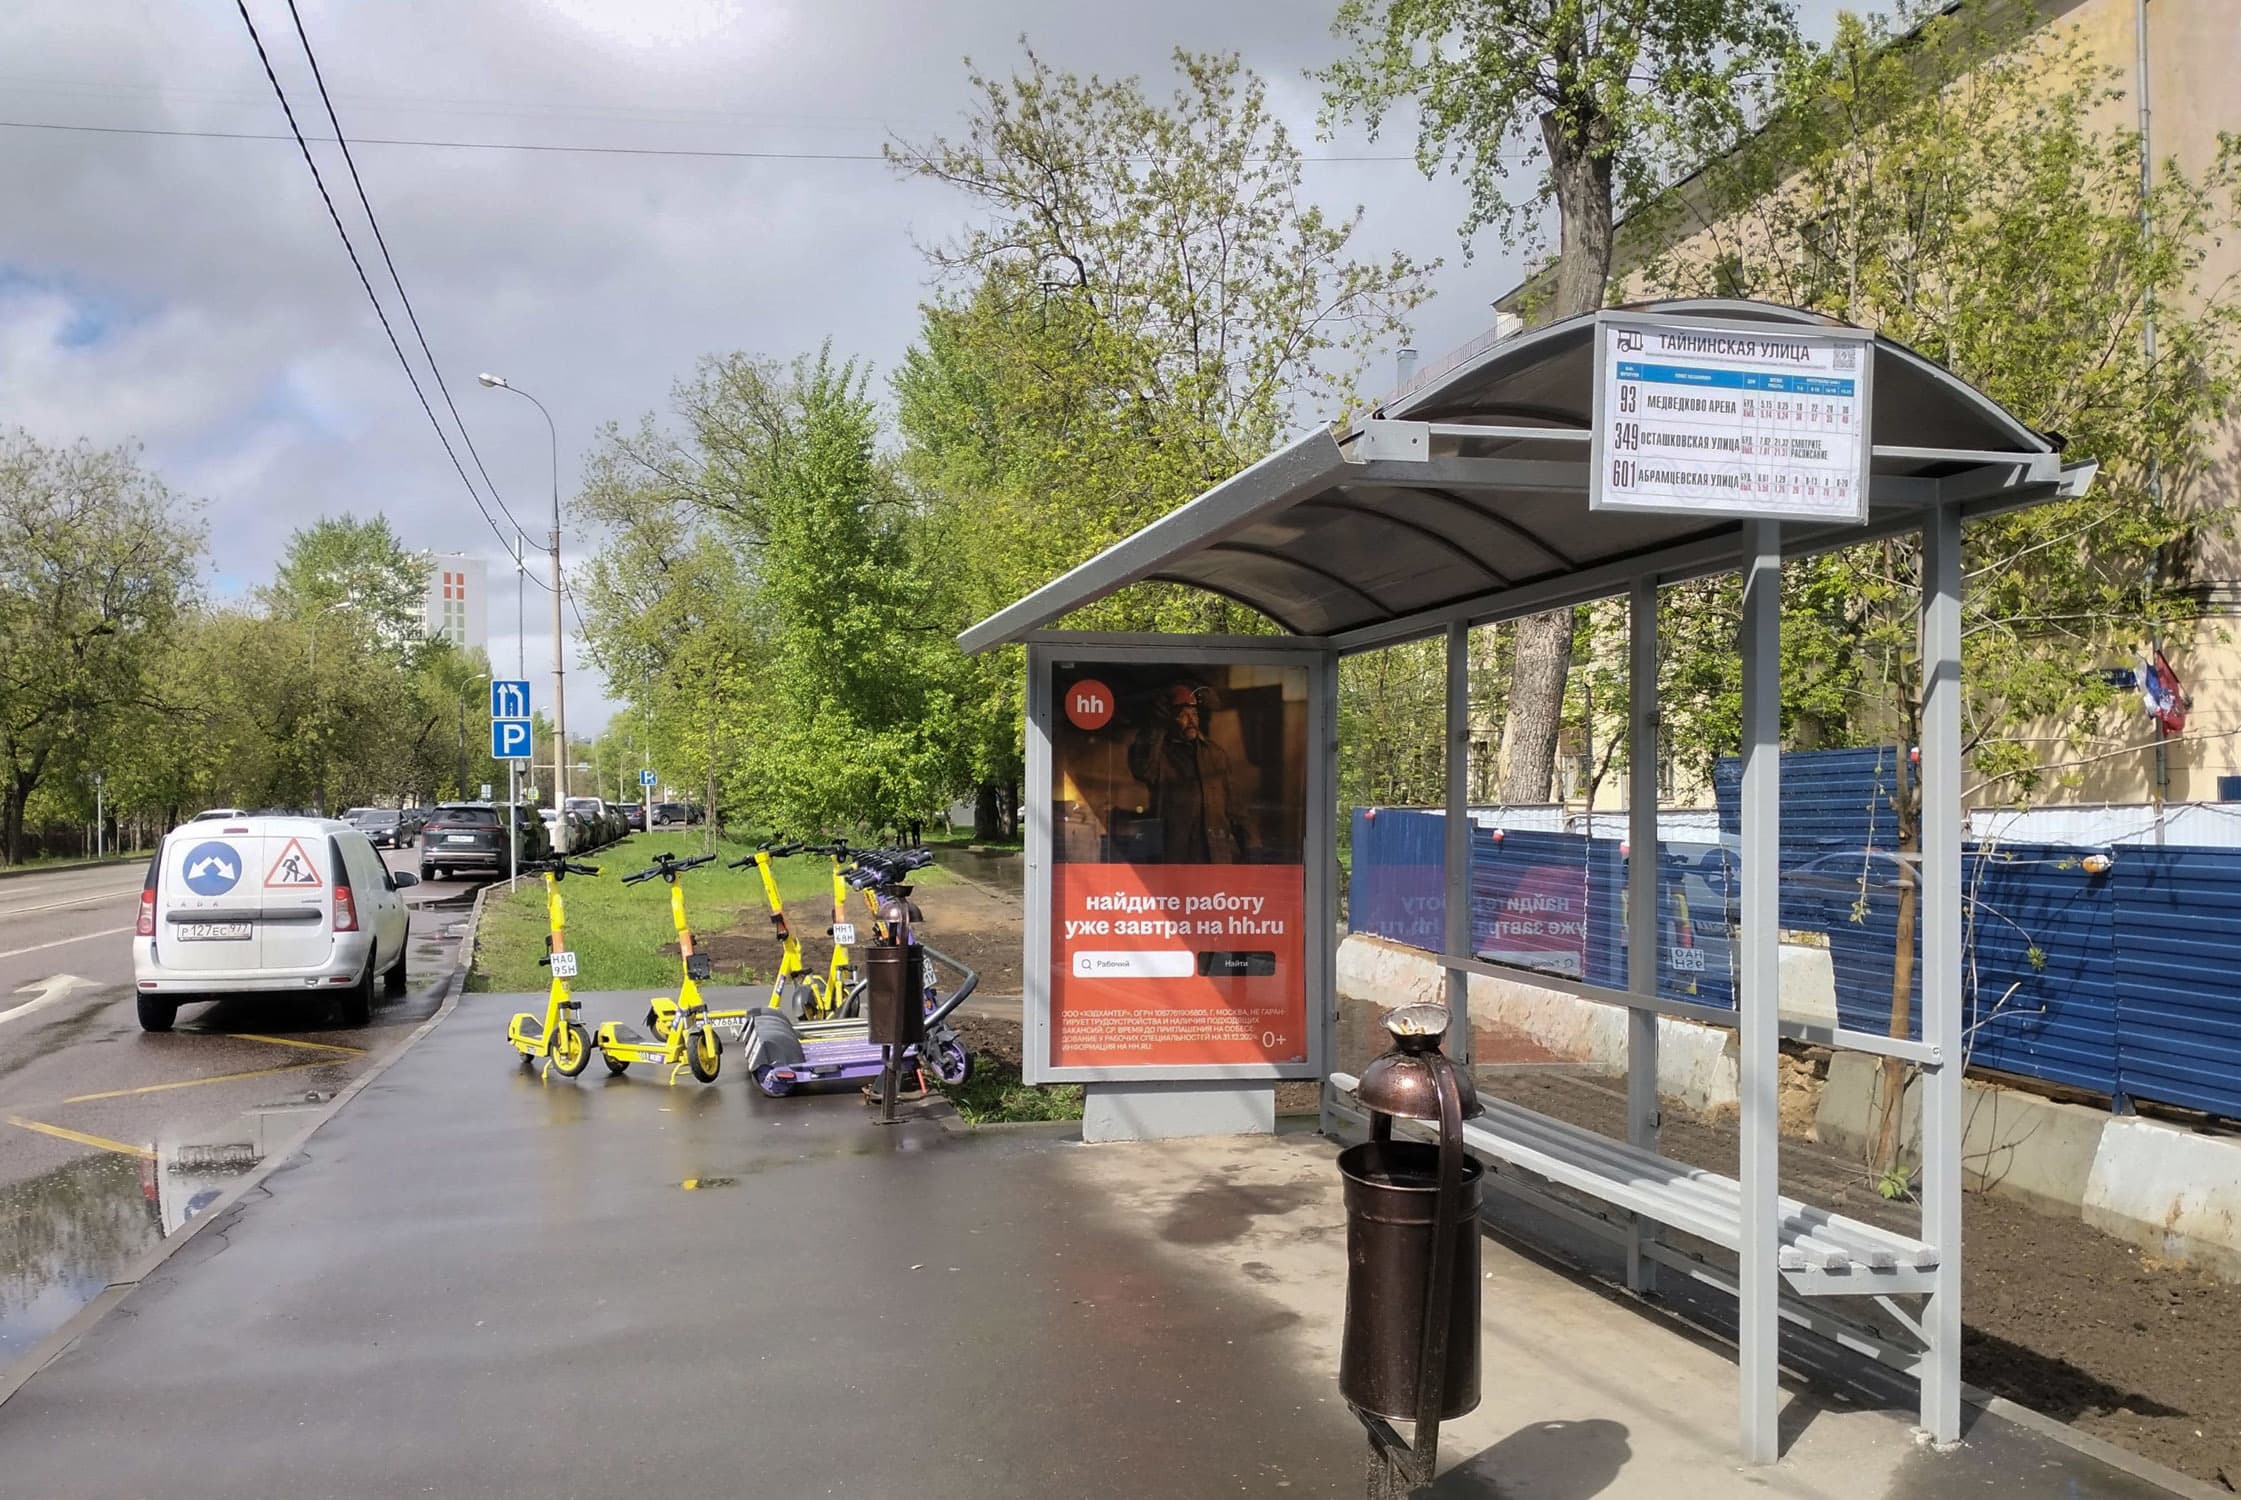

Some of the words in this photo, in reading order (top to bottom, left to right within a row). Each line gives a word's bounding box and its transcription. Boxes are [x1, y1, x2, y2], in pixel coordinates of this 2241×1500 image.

[1659, 332, 1755, 357] ТАЙНИНСКАЯ
[1761, 343, 1810, 362] УЛИЦА
[1620, 385, 1636, 413] 93
[1647, 395, 1707, 412] МЕДВЕДКОВО
[1708, 400, 1737, 414] АРЕНА
[1614, 422, 1639, 451] 349
[1640, 432, 1709, 449] ОСТАШКОВСКАЯ
[1711, 437, 1740, 452] УЛИЦА
[1791, 439, 1822, 450] СМОТРИТЕ
[1612, 459, 1636, 488] 601
[1638, 469, 1709, 486] АБРАМЦЕВСКАЯ
[1710, 474, 1739, 489] УЛИЦА
[1076, 694, 1105, 713] hh
[503, 724, 526, 754] P
[1086, 891, 1180, 913] найдите
[1185, 892, 1264, 914] работу
[1065, 920, 1109, 939] уже
[1114, 920, 1191, 939] завтра
[1197, 921, 1223, 935] на
[1229, 916, 1284, 935] hh.ru
[1096, 960, 1130, 968] Рабочий
[1225, 960, 1248, 968] Найти
[1262, 1031, 1287, 1048] 0+
